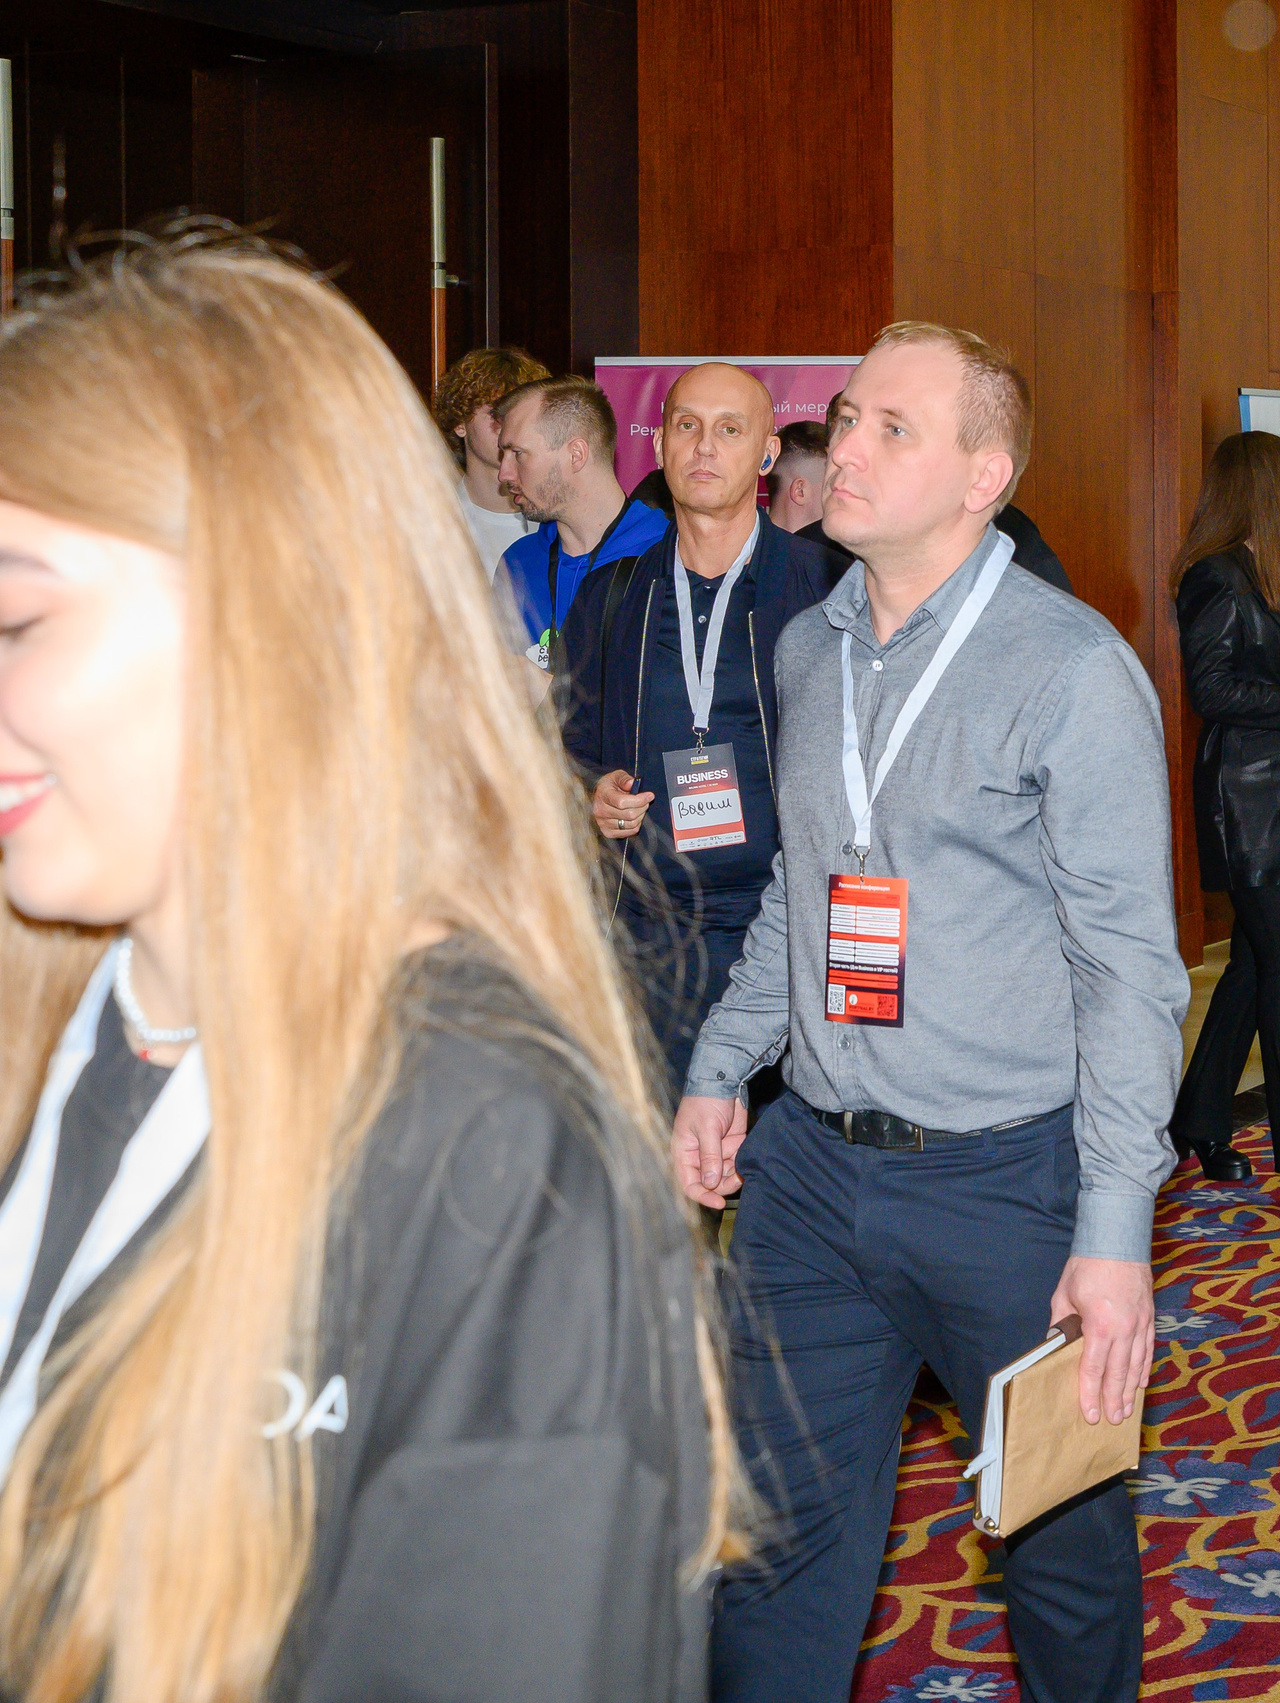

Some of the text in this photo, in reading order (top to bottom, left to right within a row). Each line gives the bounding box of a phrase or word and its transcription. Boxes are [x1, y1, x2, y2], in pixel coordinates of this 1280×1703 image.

[796, 403, 829, 416] мер
[677, 769, 728, 784] BUSINESS
[678, 798, 732, 818] Вадим
